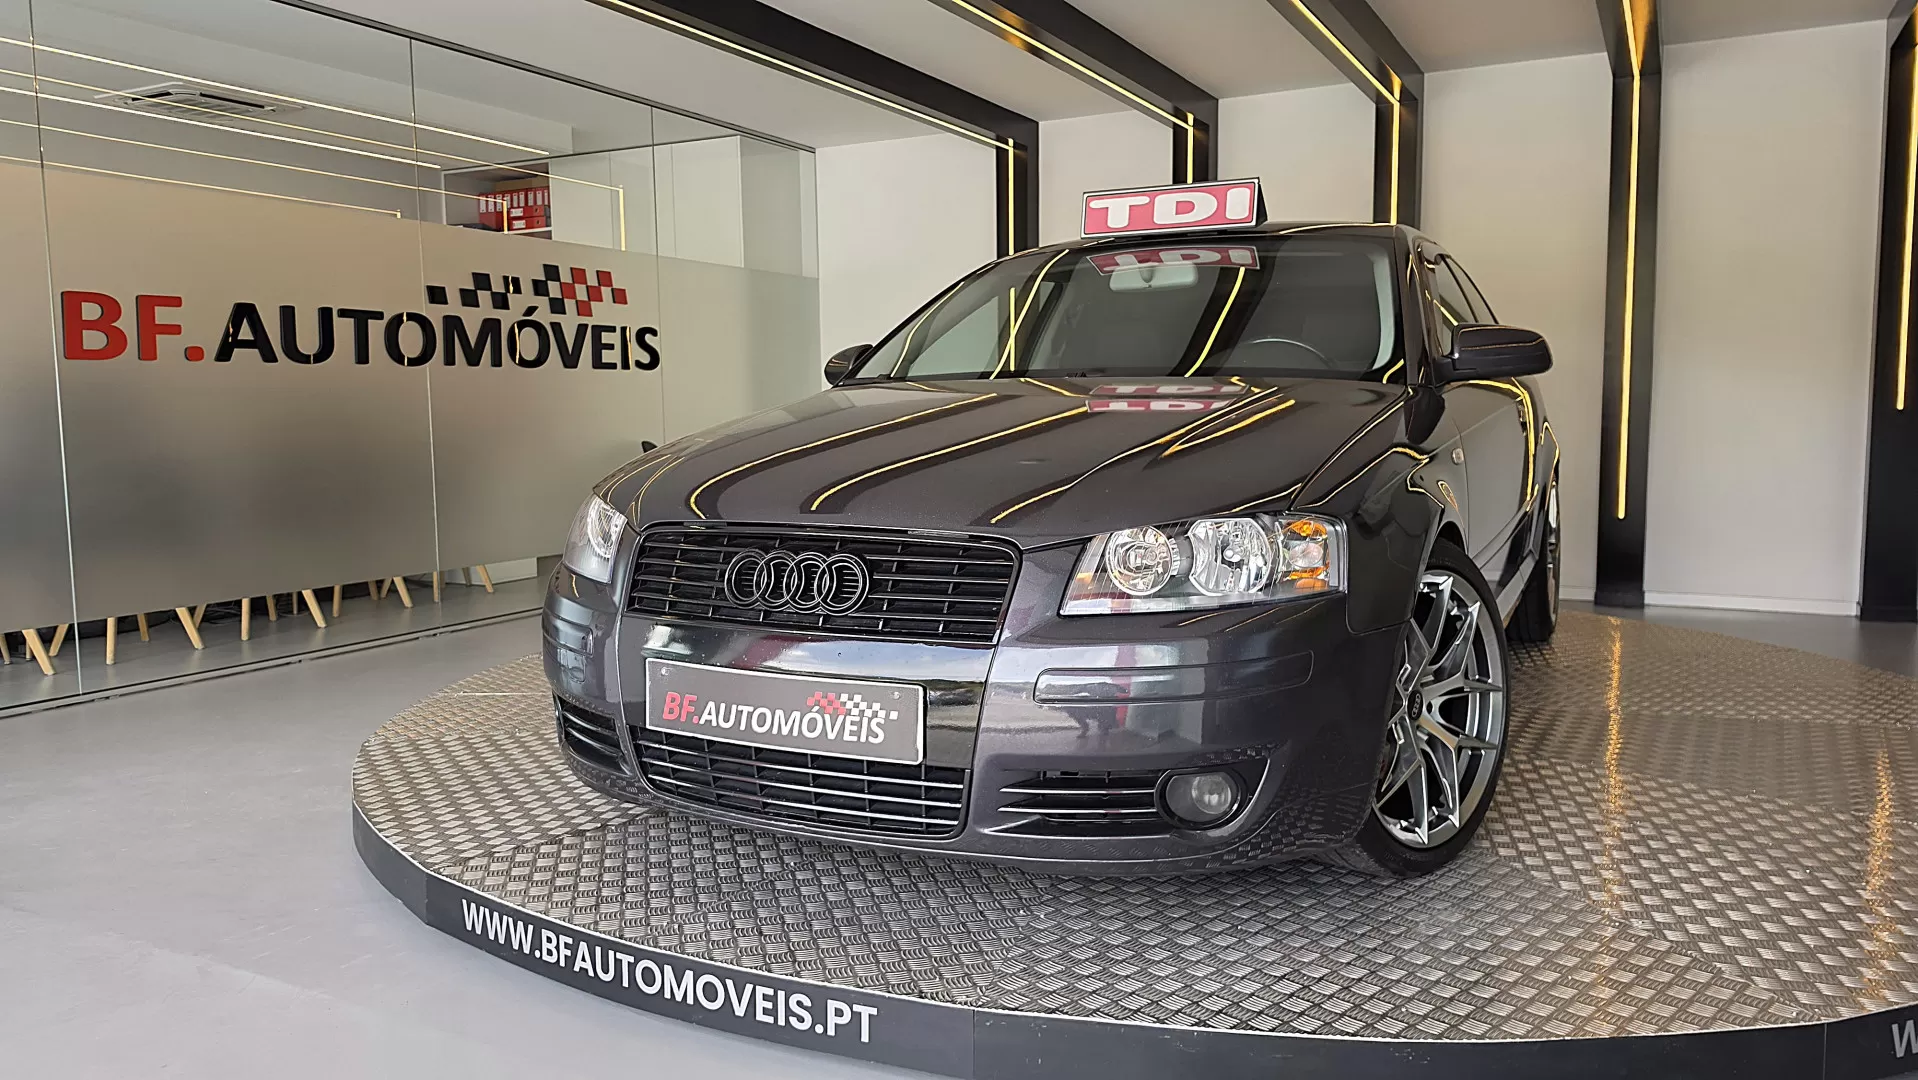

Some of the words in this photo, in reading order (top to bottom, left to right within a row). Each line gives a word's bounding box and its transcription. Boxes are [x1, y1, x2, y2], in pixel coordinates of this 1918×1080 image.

[1089, 187, 1252, 229] TDI
[61, 290, 661, 371] BF.AUTOMÓVEIS
[662, 691, 886, 744] BF.AUTOMÓVEIS
[462, 898, 878, 1043] WWW.BFAUTOMOVEIS.PT
